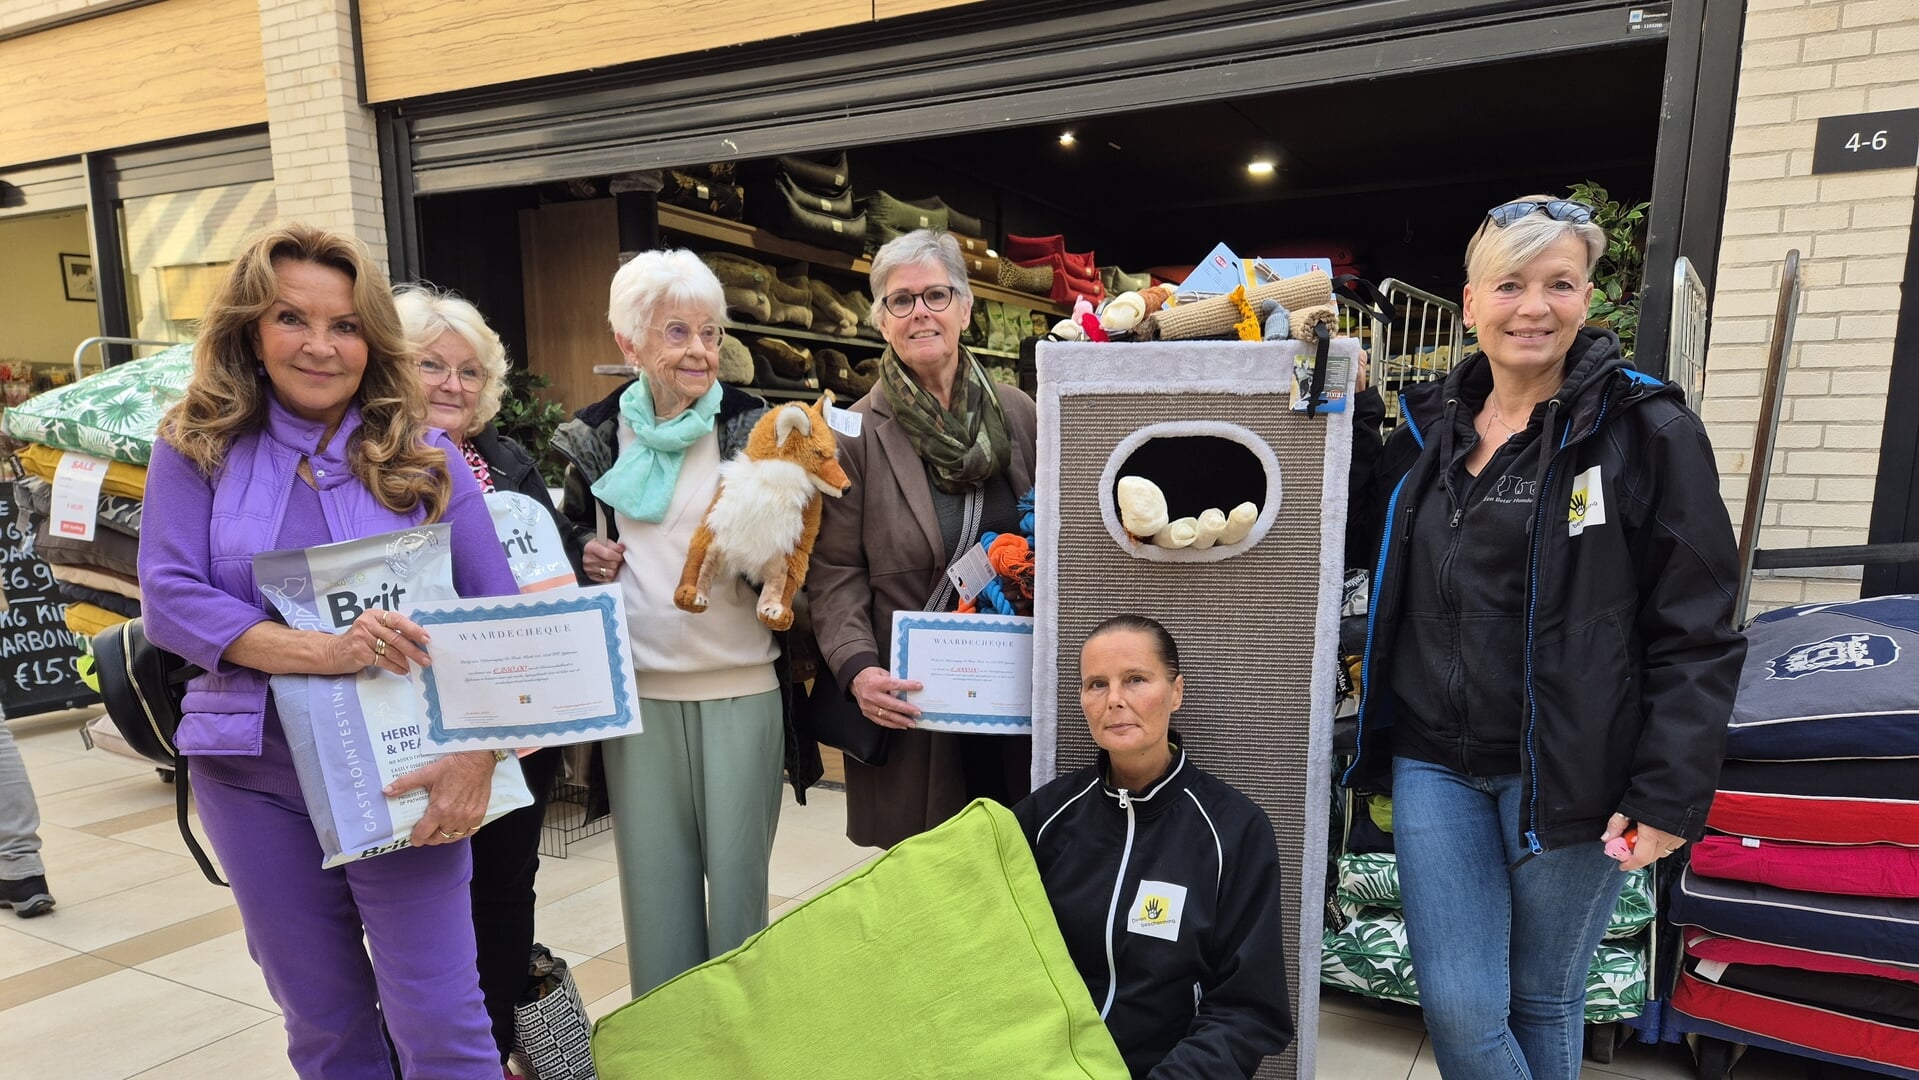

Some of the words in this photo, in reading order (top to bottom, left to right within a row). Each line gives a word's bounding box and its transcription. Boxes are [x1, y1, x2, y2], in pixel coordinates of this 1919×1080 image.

[1844, 130, 1888, 153] 4-6
[71, 460, 97, 472] SALE
[0, 500, 9, 517] E
[500, 528, 538, 559] rit
[1, 562, 60, 592] €6.9
[326, 582, 406, 629] Brit
[458, 623, 573, 642] WAARDECHEQUE
[0, 628, 79, 659] ARBON
[933, 637, 1015, 649] WAARDECHEQUE
[381, 724, 420, 742] HERRI
[386, 743, 398, 755] &
[406, 794, 430, 804] PATHOGE
[360, 838, 411, 859] Brit
[571, 1055, 592, 1072] ZEEMA
